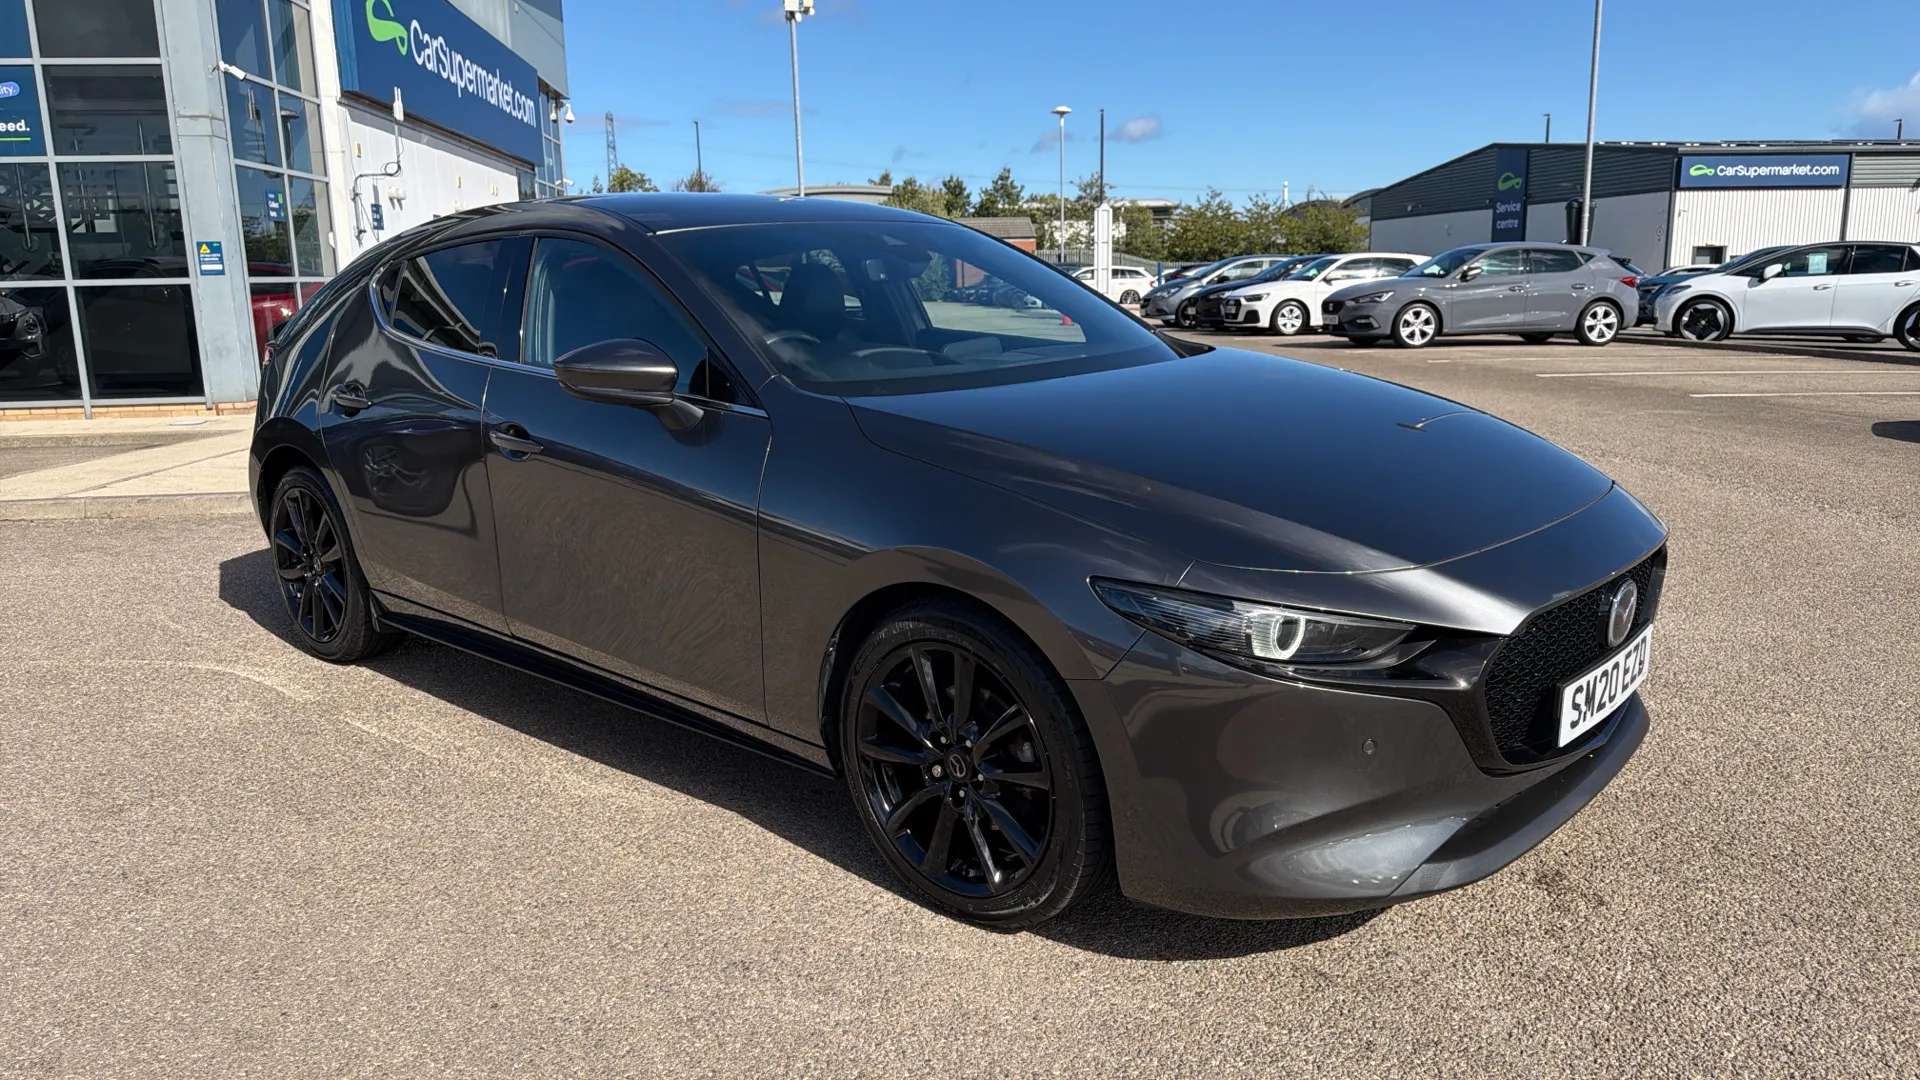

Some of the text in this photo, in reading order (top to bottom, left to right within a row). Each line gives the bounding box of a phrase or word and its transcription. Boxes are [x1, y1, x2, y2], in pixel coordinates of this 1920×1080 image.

[410, 19, 536, 128] CarSupermarket.com
[1716, 164, 1840, 178] CarSupermarket.com
[1496, 201, 1521, 213] Service
[1496, 219, 1519, 229] centre
[1570, 660, 1620, 730] SM20
